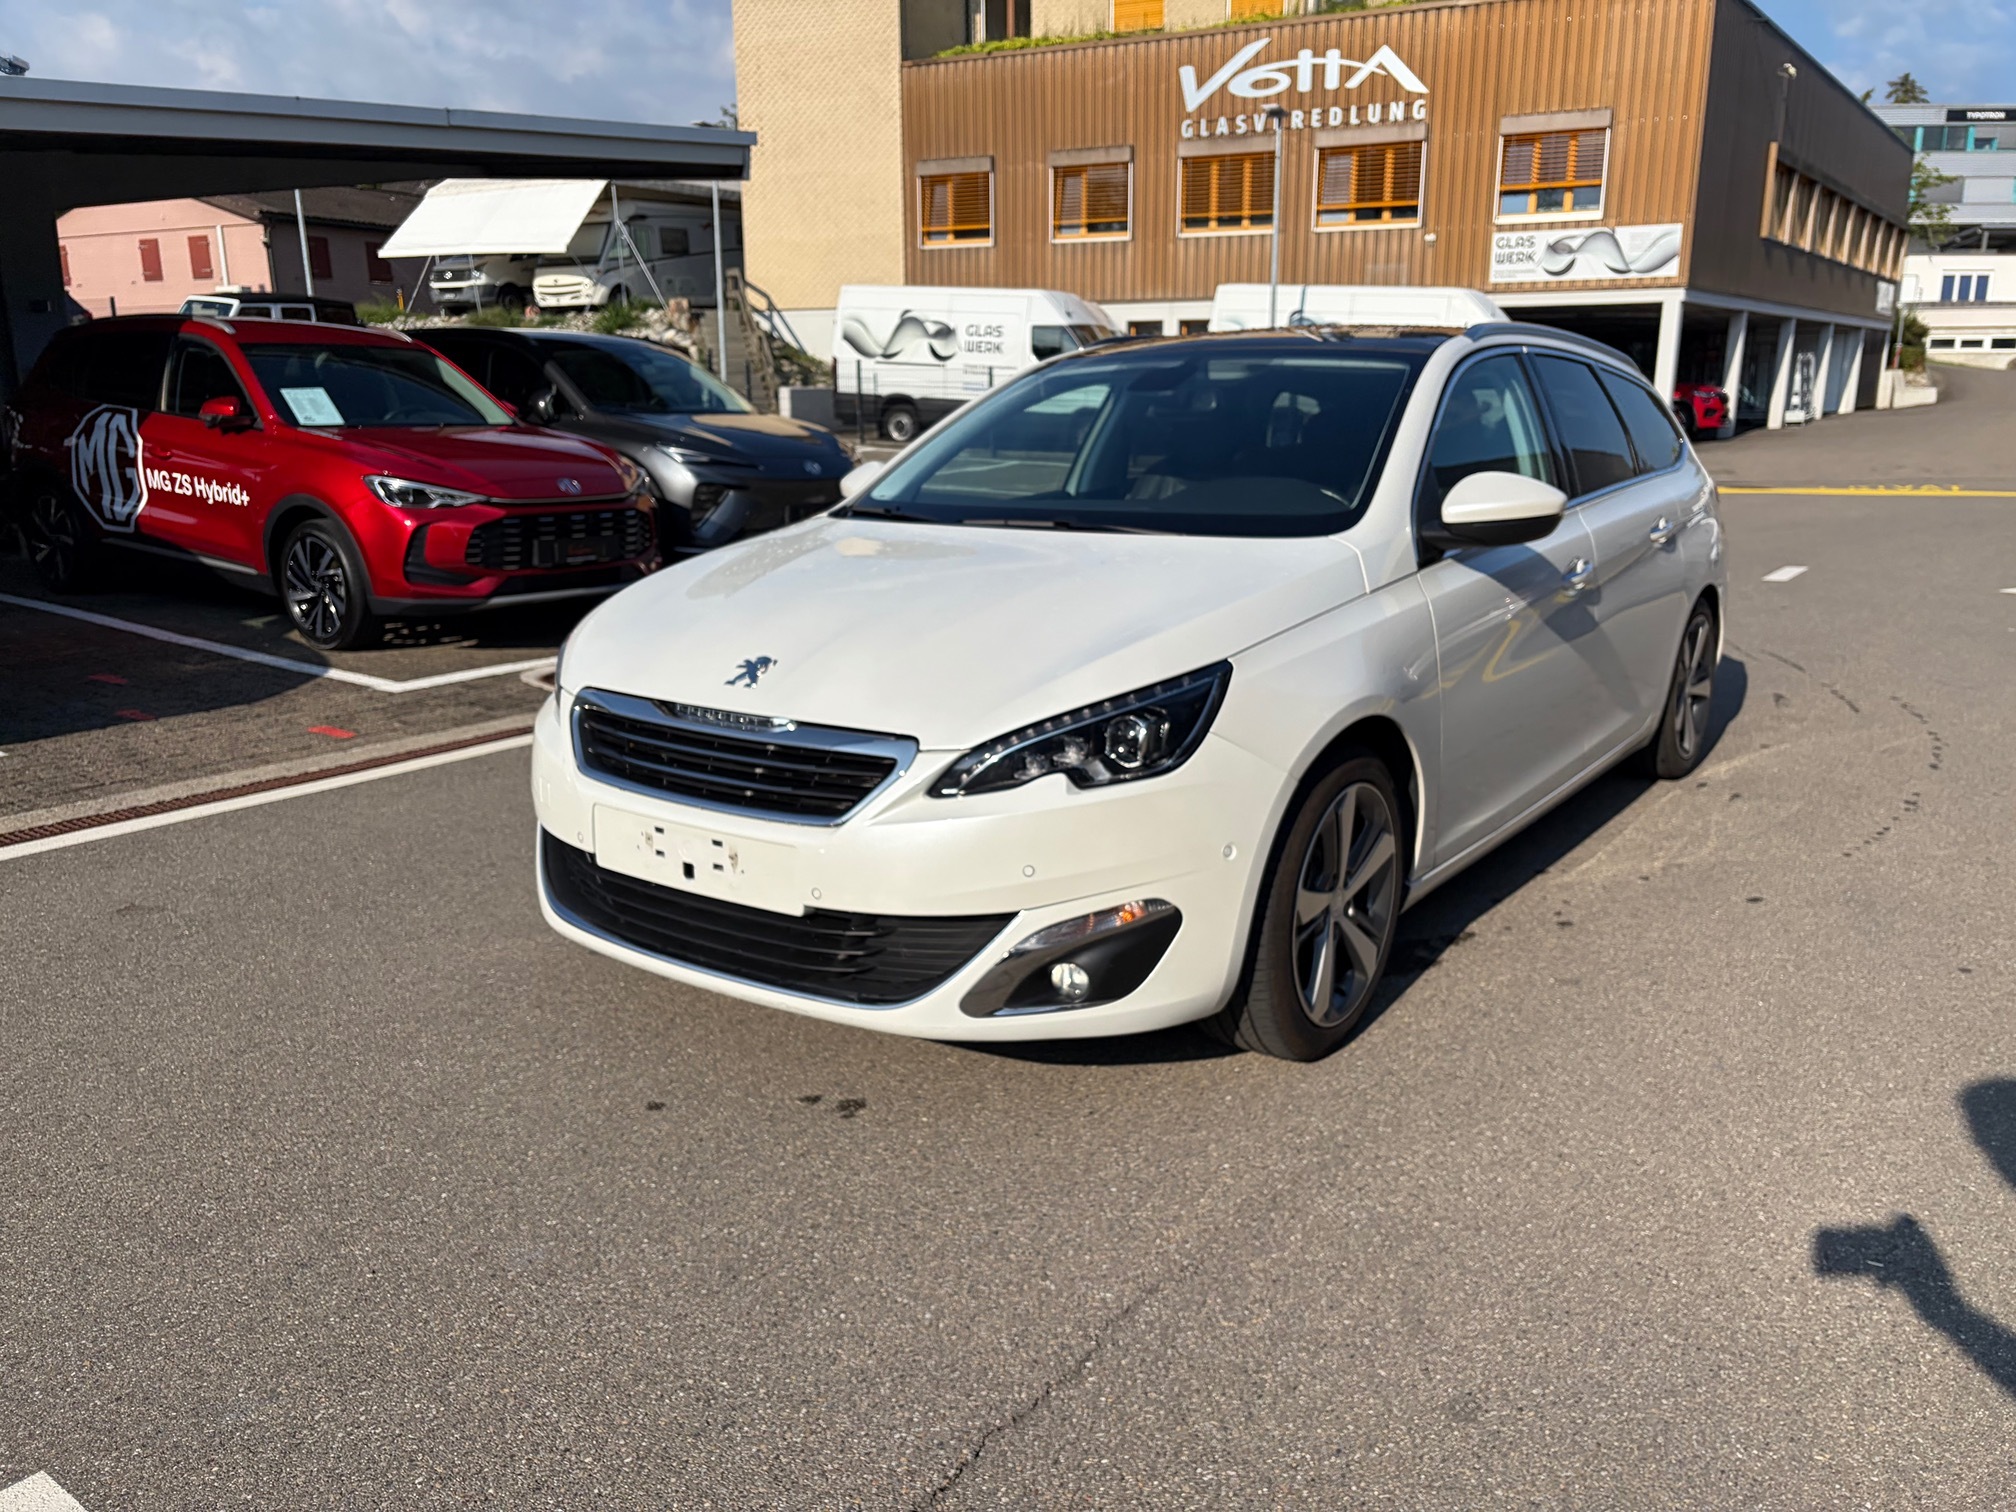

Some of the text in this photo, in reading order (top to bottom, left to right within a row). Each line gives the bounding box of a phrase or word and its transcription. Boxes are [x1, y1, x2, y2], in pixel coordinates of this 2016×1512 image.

[1495, 234, 1537, 249] GLAS
[1494, 250, 1537, 265] WERK
[965, 324, 1004, 338] GLAS
[964, 340, 1005, 354] WERK
[77, 410, 142, 522] MG
[145, 467, 251, 507] MG ZS Hybrid+
